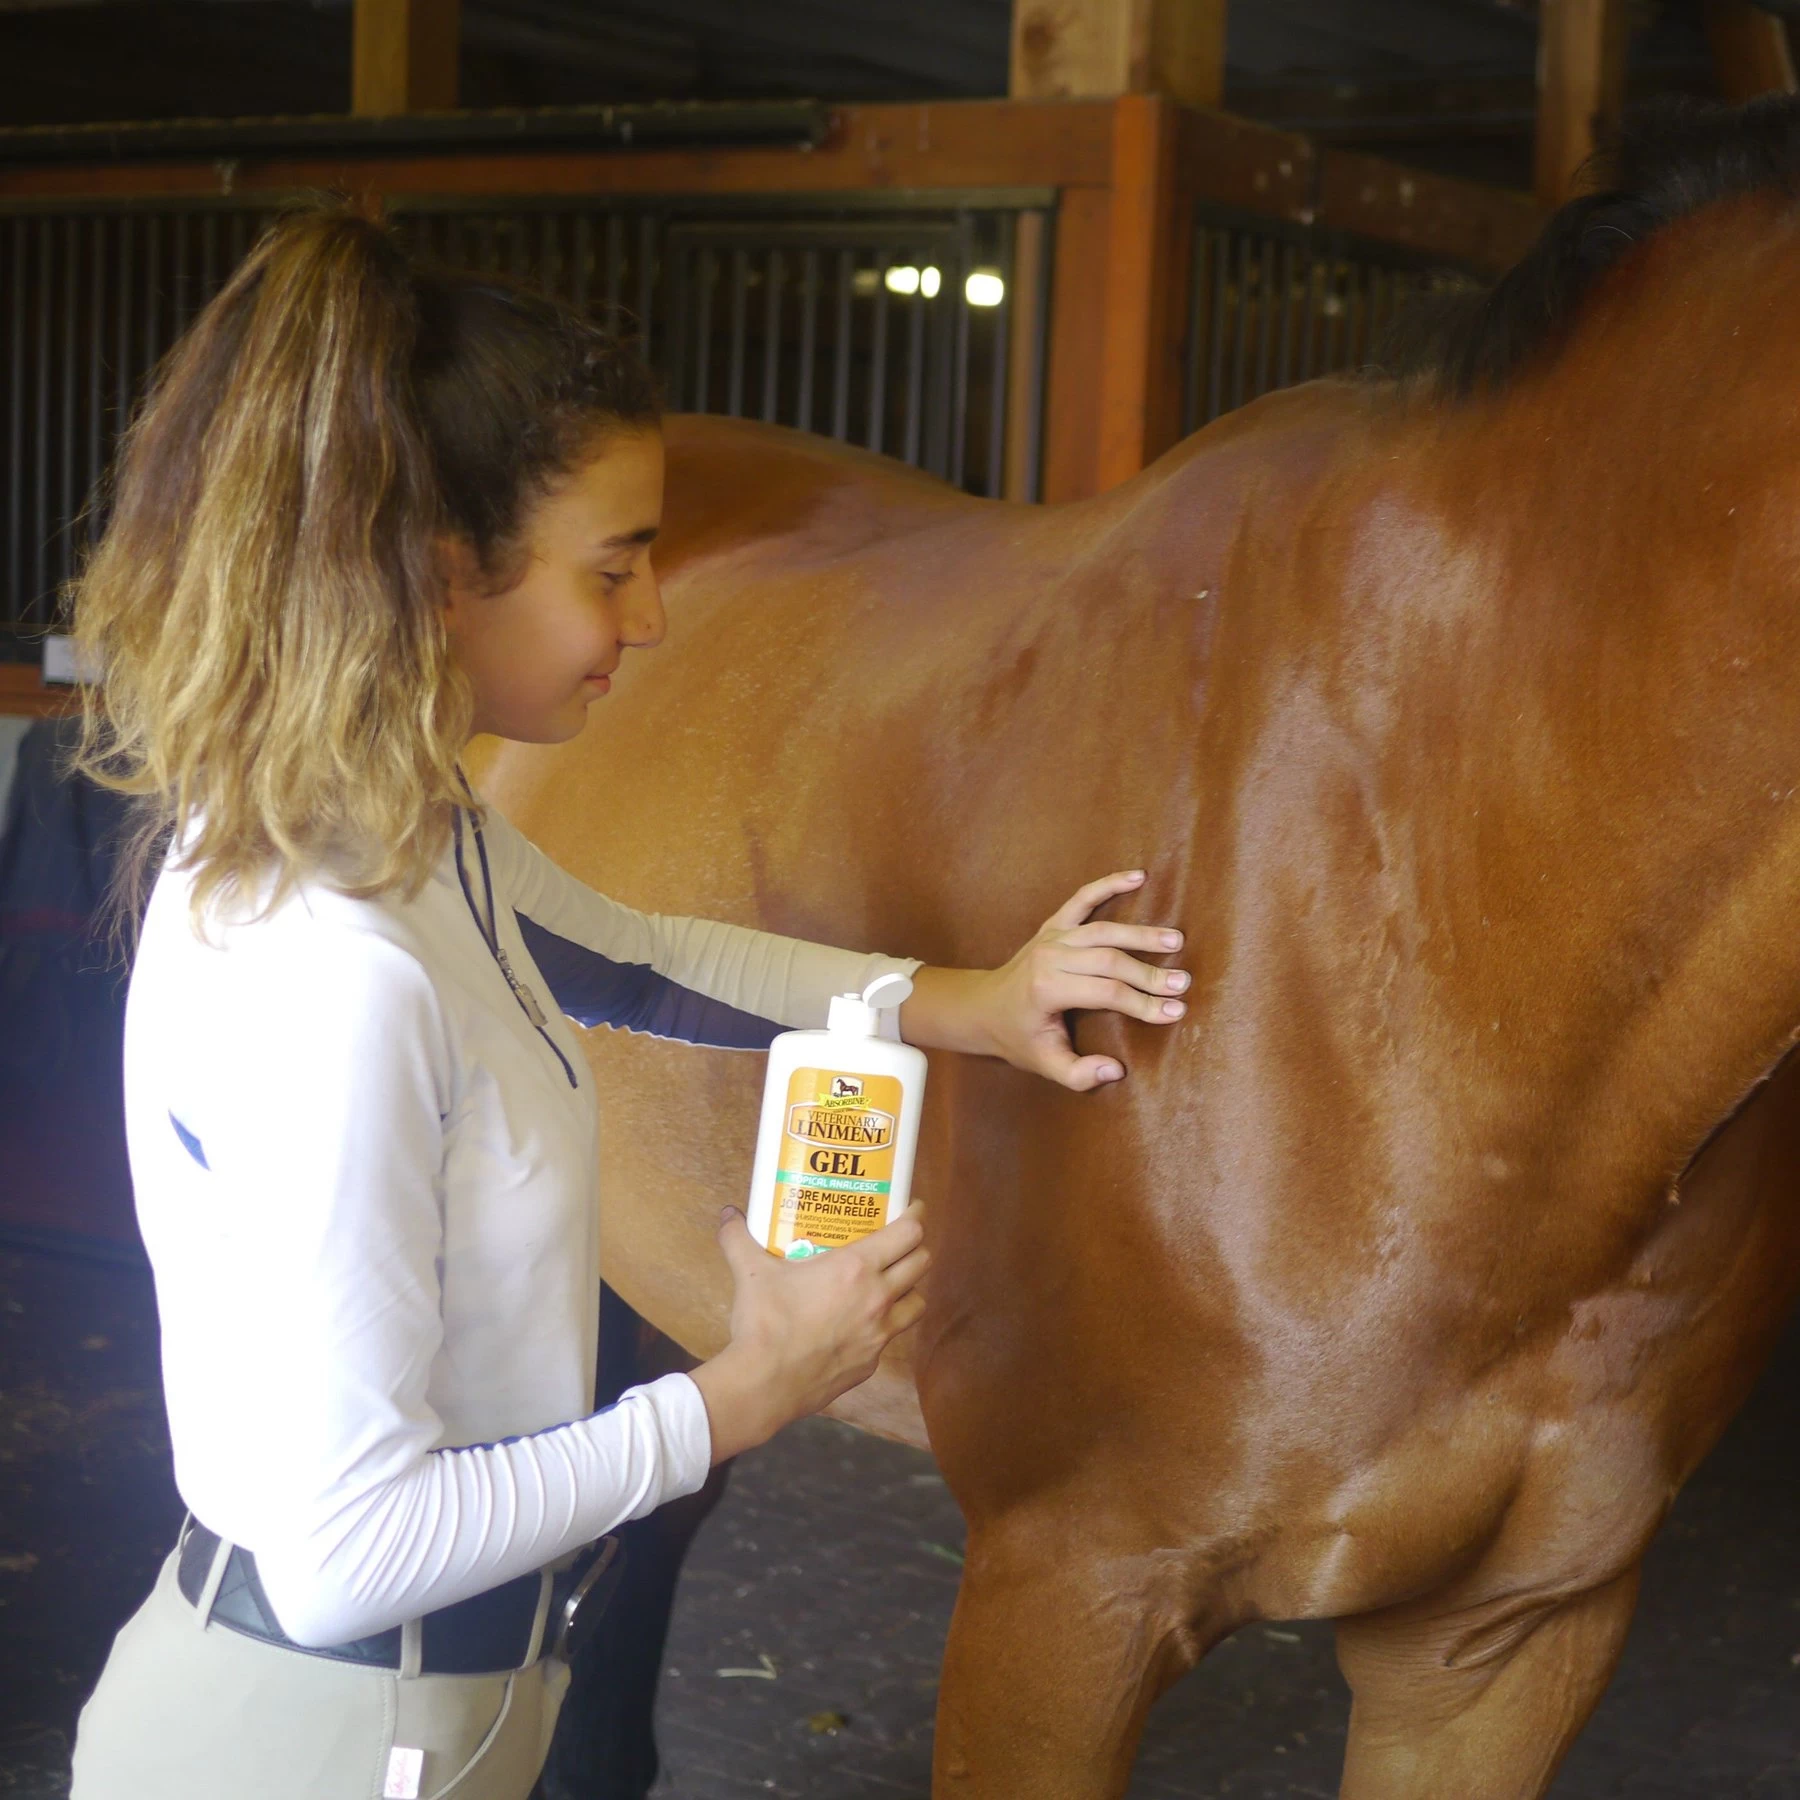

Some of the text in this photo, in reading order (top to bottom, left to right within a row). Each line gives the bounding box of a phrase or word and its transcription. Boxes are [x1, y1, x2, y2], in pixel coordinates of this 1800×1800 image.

[824, 1097, 865, 1108] ABSORBINE
[808, 1110, 879, 1128] VETERINARY
[797, 1119, 886, 1144] LINIMENT
[809, 1150, 866, 1177] GEL
[829, 1179, 879, 1191] ANALGESIC
[789, 1188, 875, 1207] SORE MUSCLE &
[780, 1198, 880, 1218] JOINT PAIN RELIEF
[806, 1231, 850, 1240] NON-GREASY
